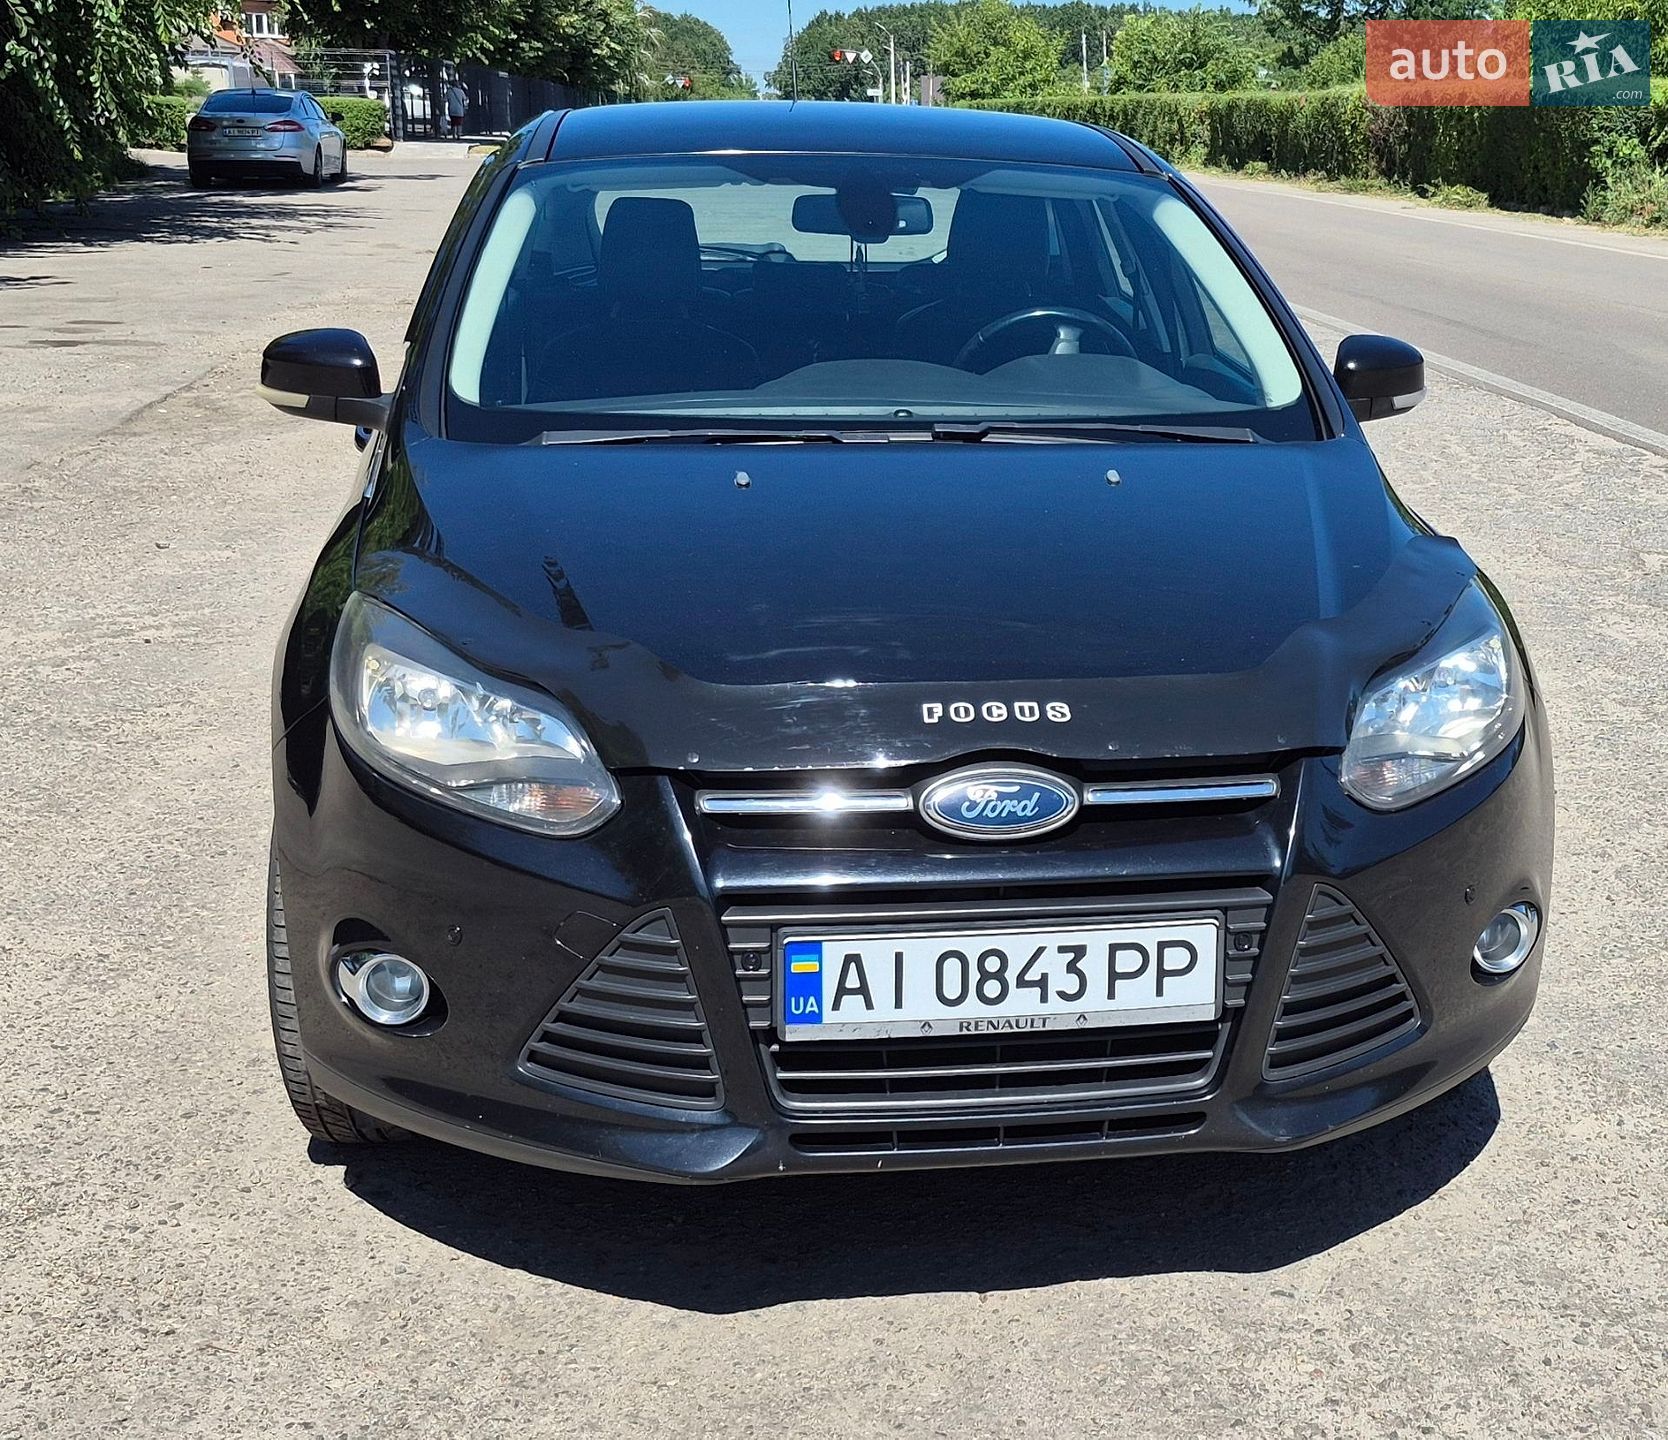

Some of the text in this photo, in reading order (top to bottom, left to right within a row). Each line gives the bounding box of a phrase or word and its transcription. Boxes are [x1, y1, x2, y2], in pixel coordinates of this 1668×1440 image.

[922, 701, 1072, 724] FOCUS
[960, 784, 1040, 819] Ford
[831, 939, 1198, 1012] AI 0843 PP
[791, 996, 819, 1014] UA
[958, 1017, 1051, 1033] RENAULT
